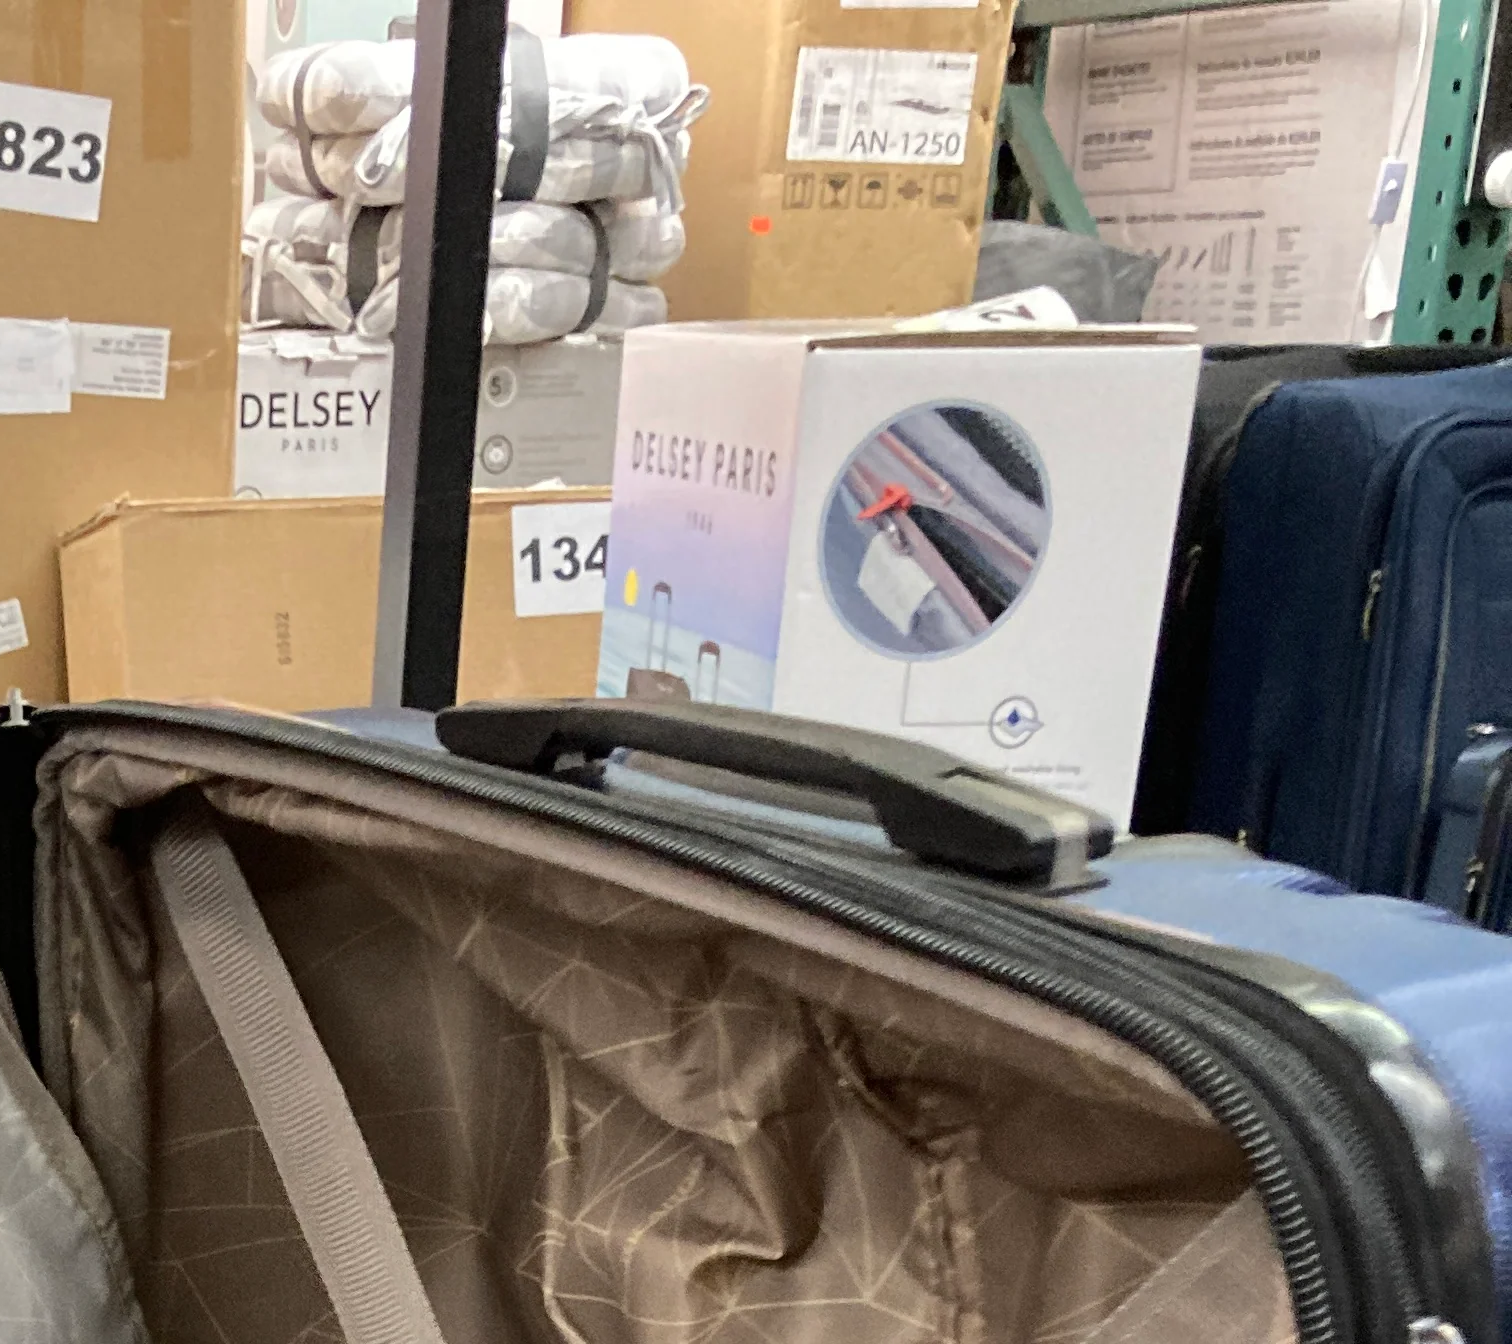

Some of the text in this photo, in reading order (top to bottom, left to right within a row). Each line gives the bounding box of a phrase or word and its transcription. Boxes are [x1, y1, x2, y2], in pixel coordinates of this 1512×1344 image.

[849, 129, 962, 157] AN-1250
[240, 389, 382, 429] DELSEY
[281, 436, 340, 452] PARIS
[631, 429, 708, 484] DELSEY
[711, 442, 778, 498] PARIS
[519, 533, 610, 583] 134
